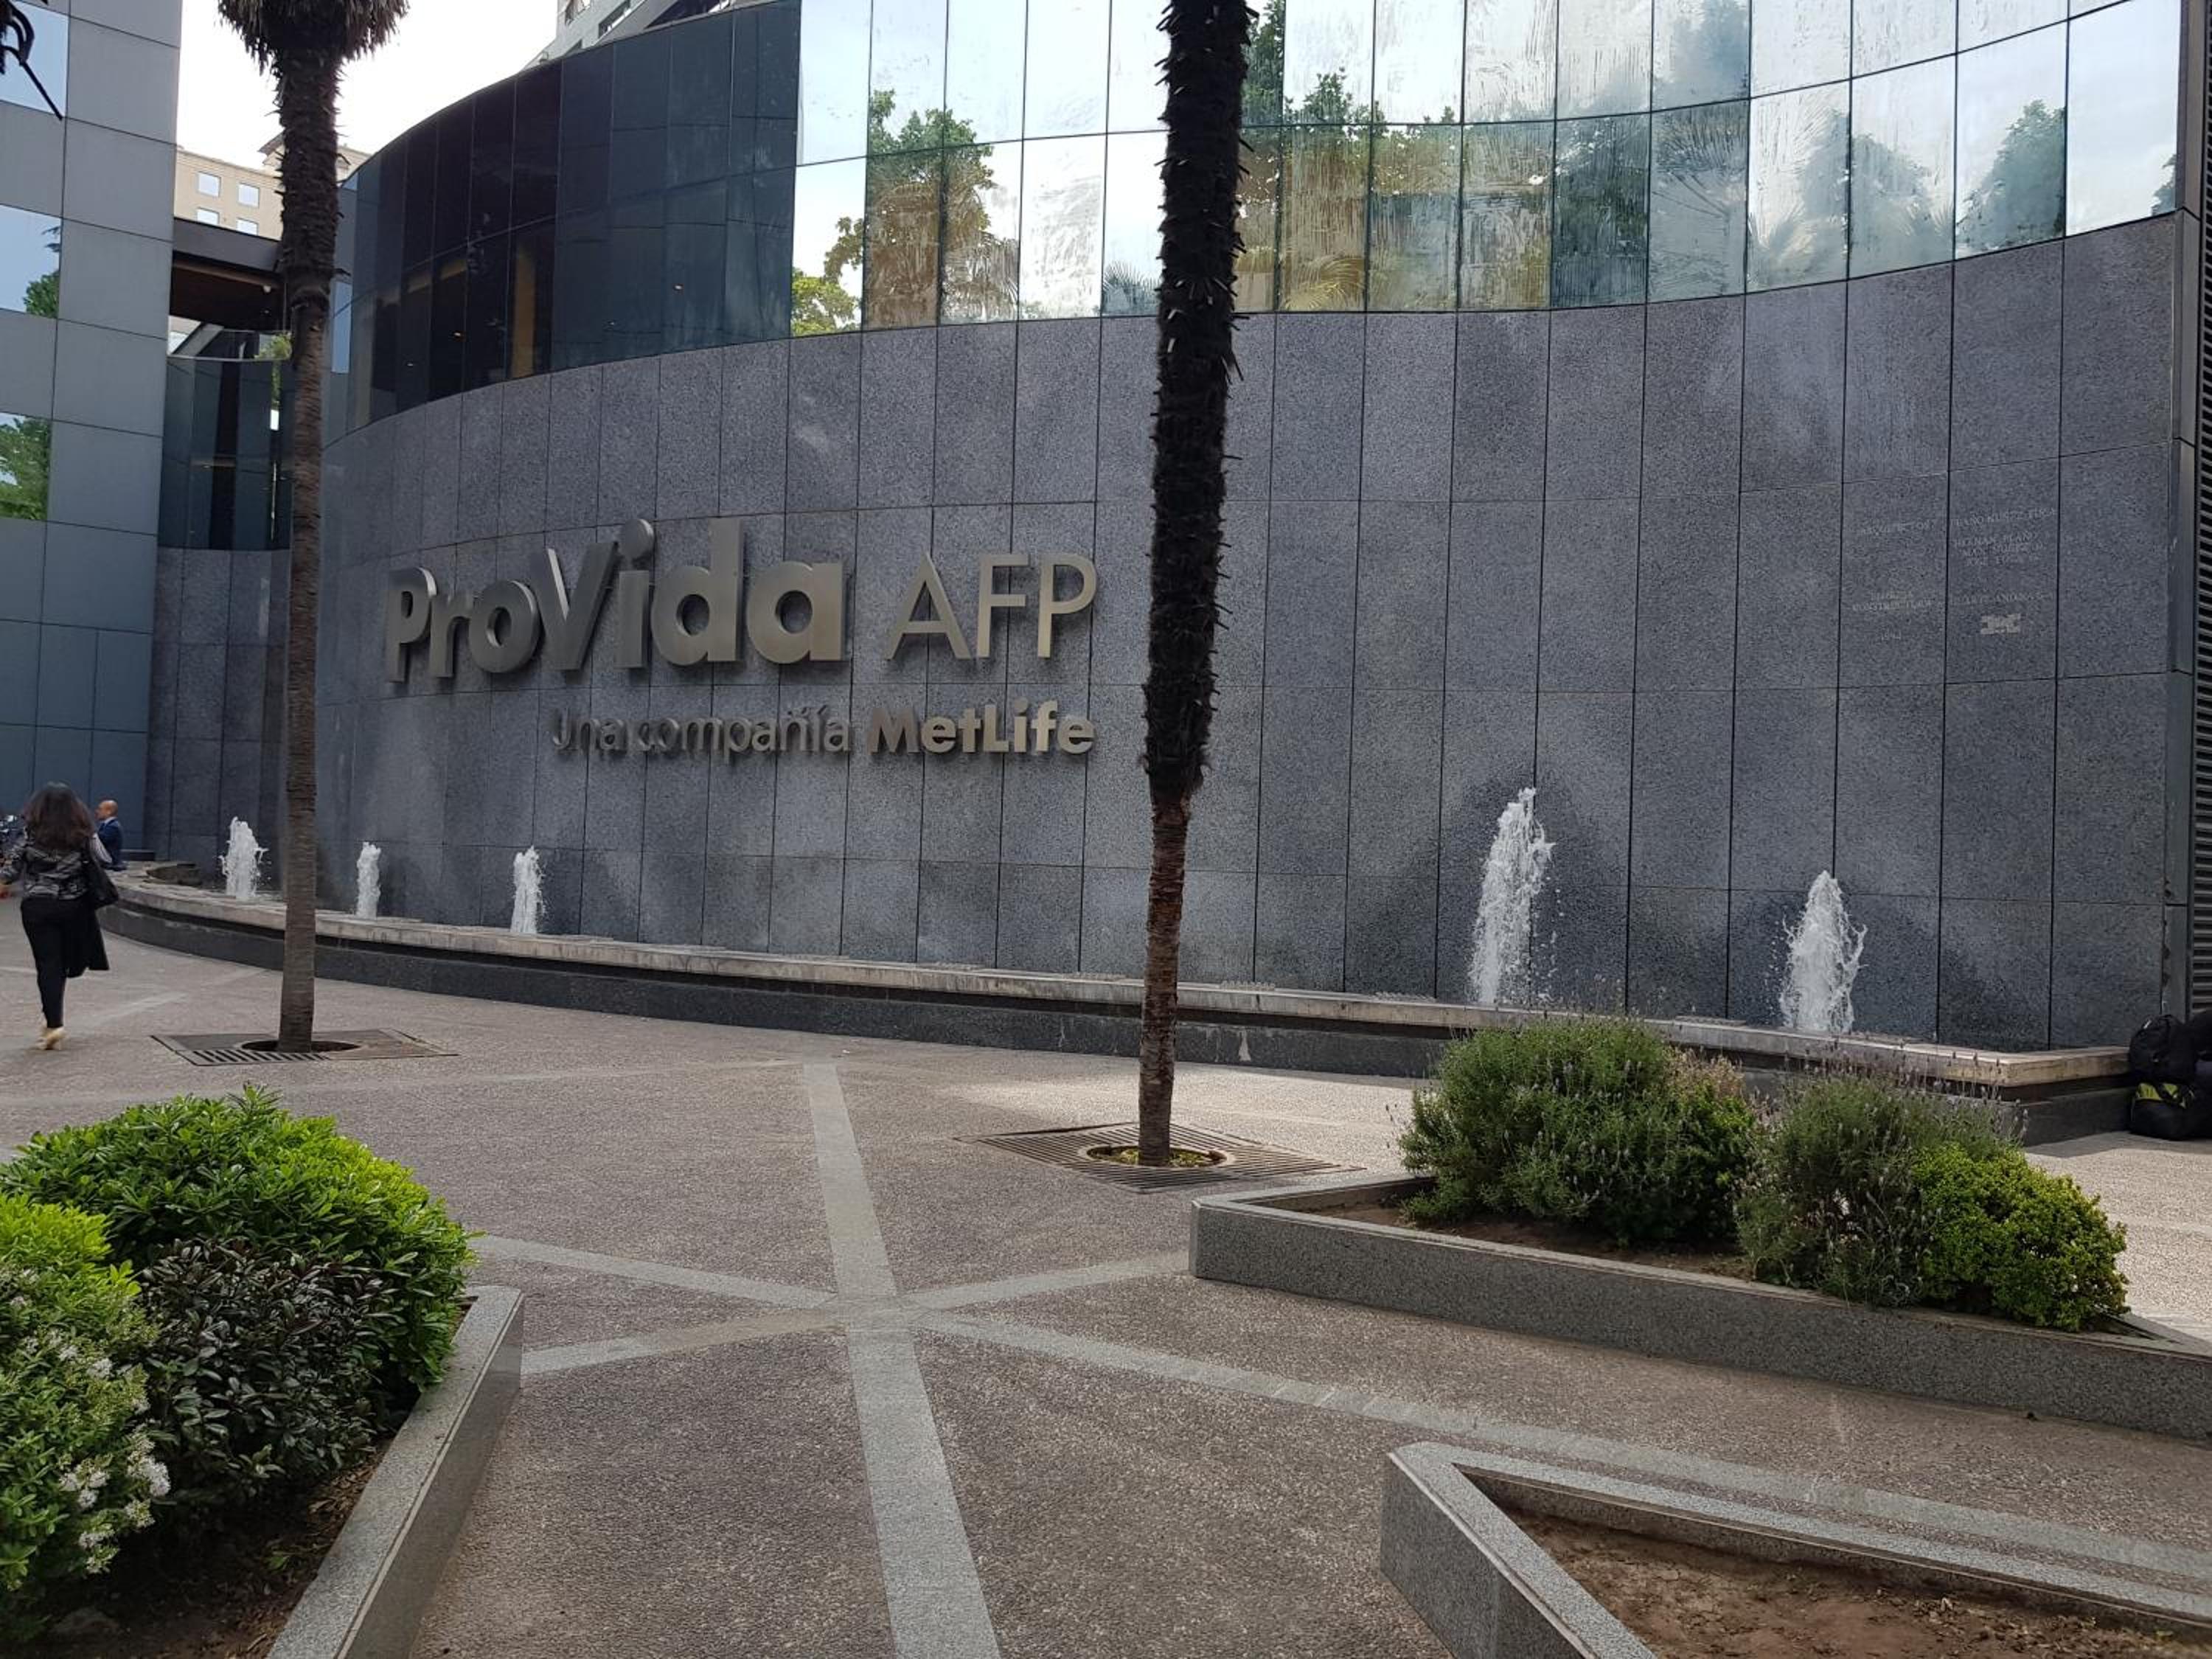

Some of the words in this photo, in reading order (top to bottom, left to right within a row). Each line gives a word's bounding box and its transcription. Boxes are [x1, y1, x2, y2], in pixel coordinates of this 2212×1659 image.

[385, 517, 846, 683] ProVida
[885, 552, 1096, 661] AFP
[634, 704, 851, 765] compañía
[865, 700, 1096, 754] MetLife
